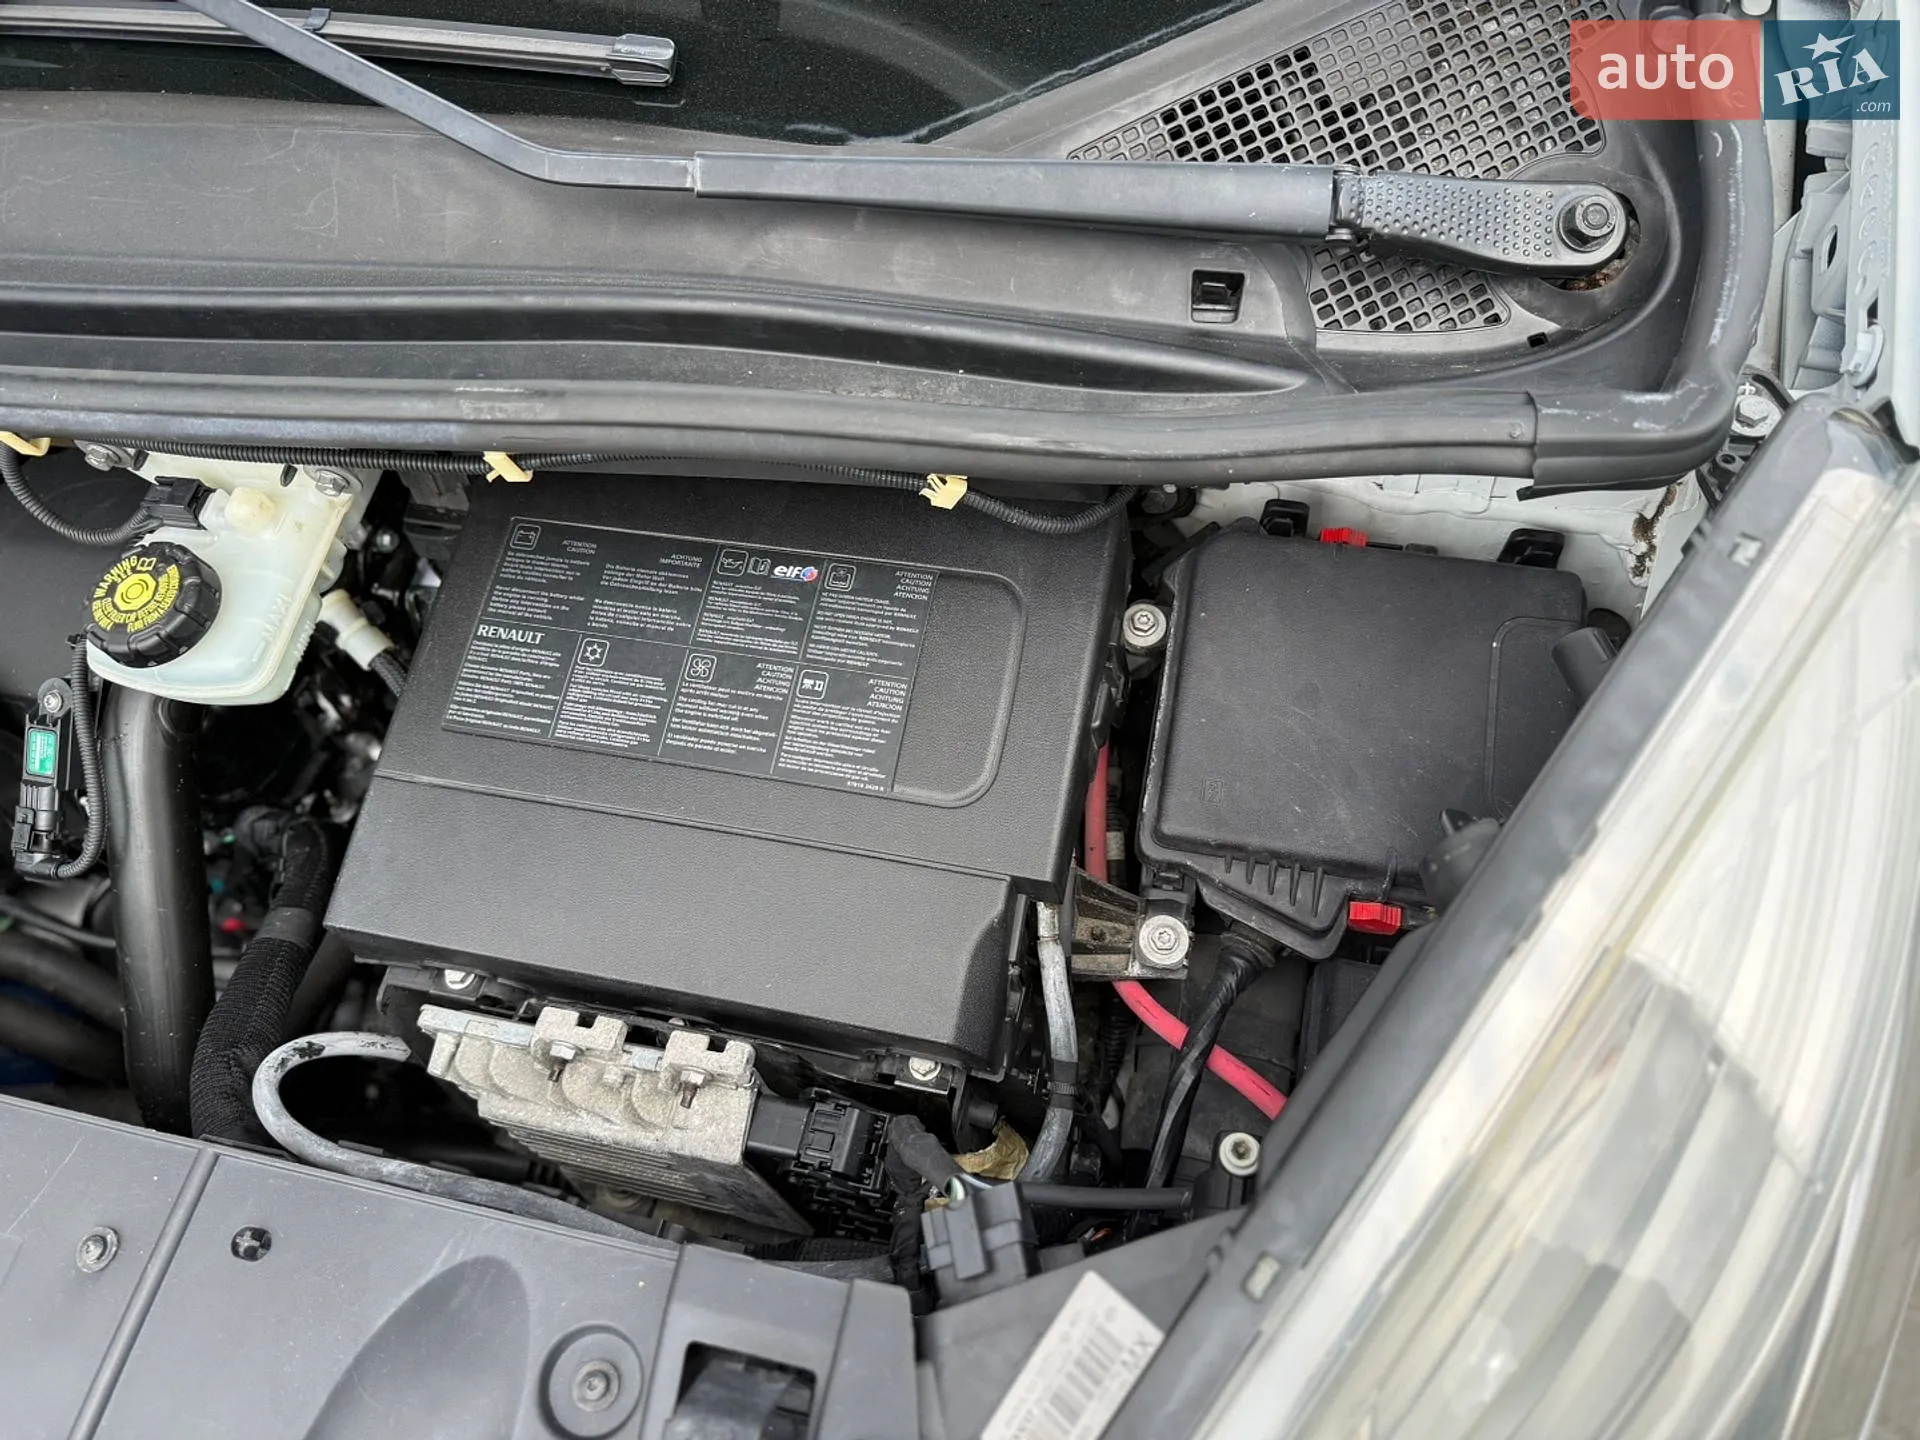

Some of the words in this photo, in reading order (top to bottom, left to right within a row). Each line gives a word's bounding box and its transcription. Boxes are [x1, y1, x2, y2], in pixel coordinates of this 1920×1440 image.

[93, 555, 138, 598] WARNING
[895, 570, 934, 581] ATTENTION
[900, 577, 932, 587] CAUTION
[896, 584, 930, 594] ACHTUNG
[477, 624, 545, 644] RENAULT
[868, 679, 907, 690] ATTENTION
[874, 686, 906, 696] CAUTION
